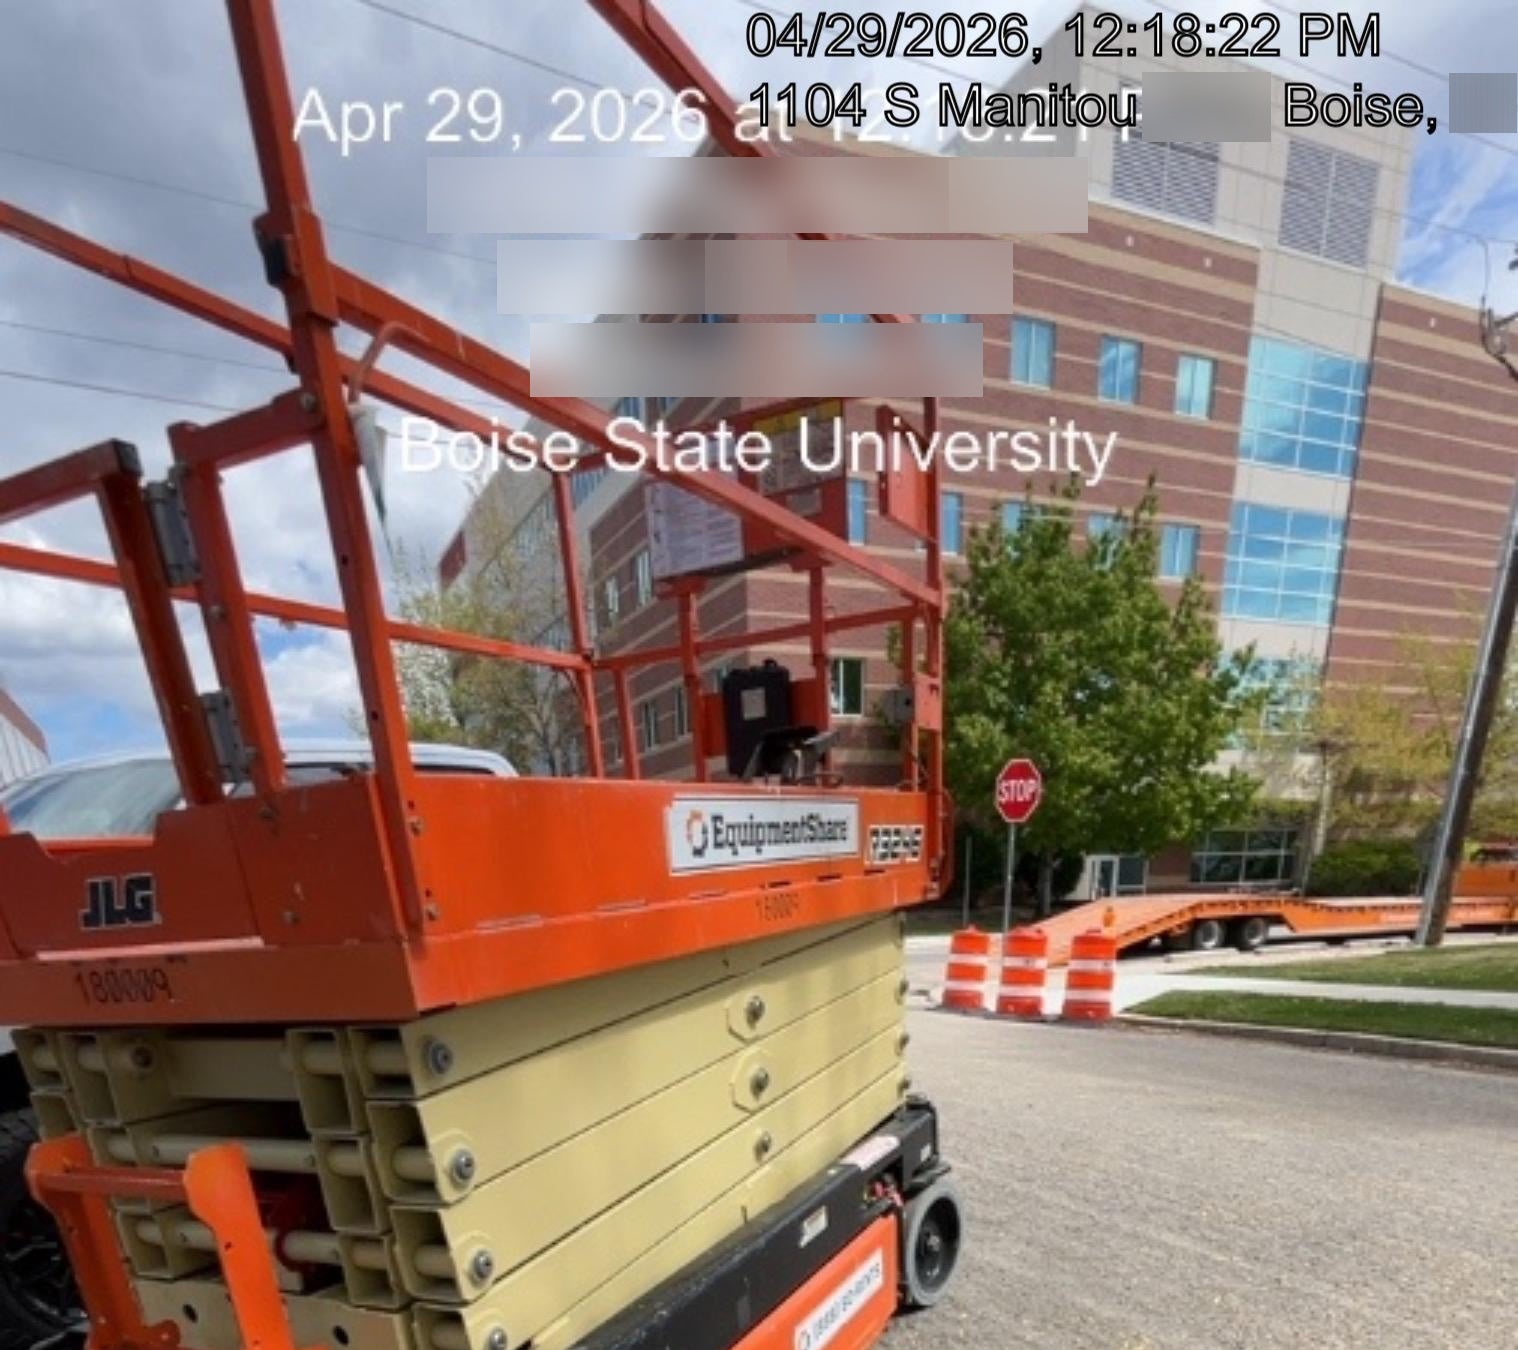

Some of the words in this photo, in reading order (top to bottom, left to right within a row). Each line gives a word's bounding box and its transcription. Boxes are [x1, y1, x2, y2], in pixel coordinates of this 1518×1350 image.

[999, 778, 1038, 804] STOP
[711, 812, 848, 856] EquipmentShare
[79, 872, 162, 931] JLG
